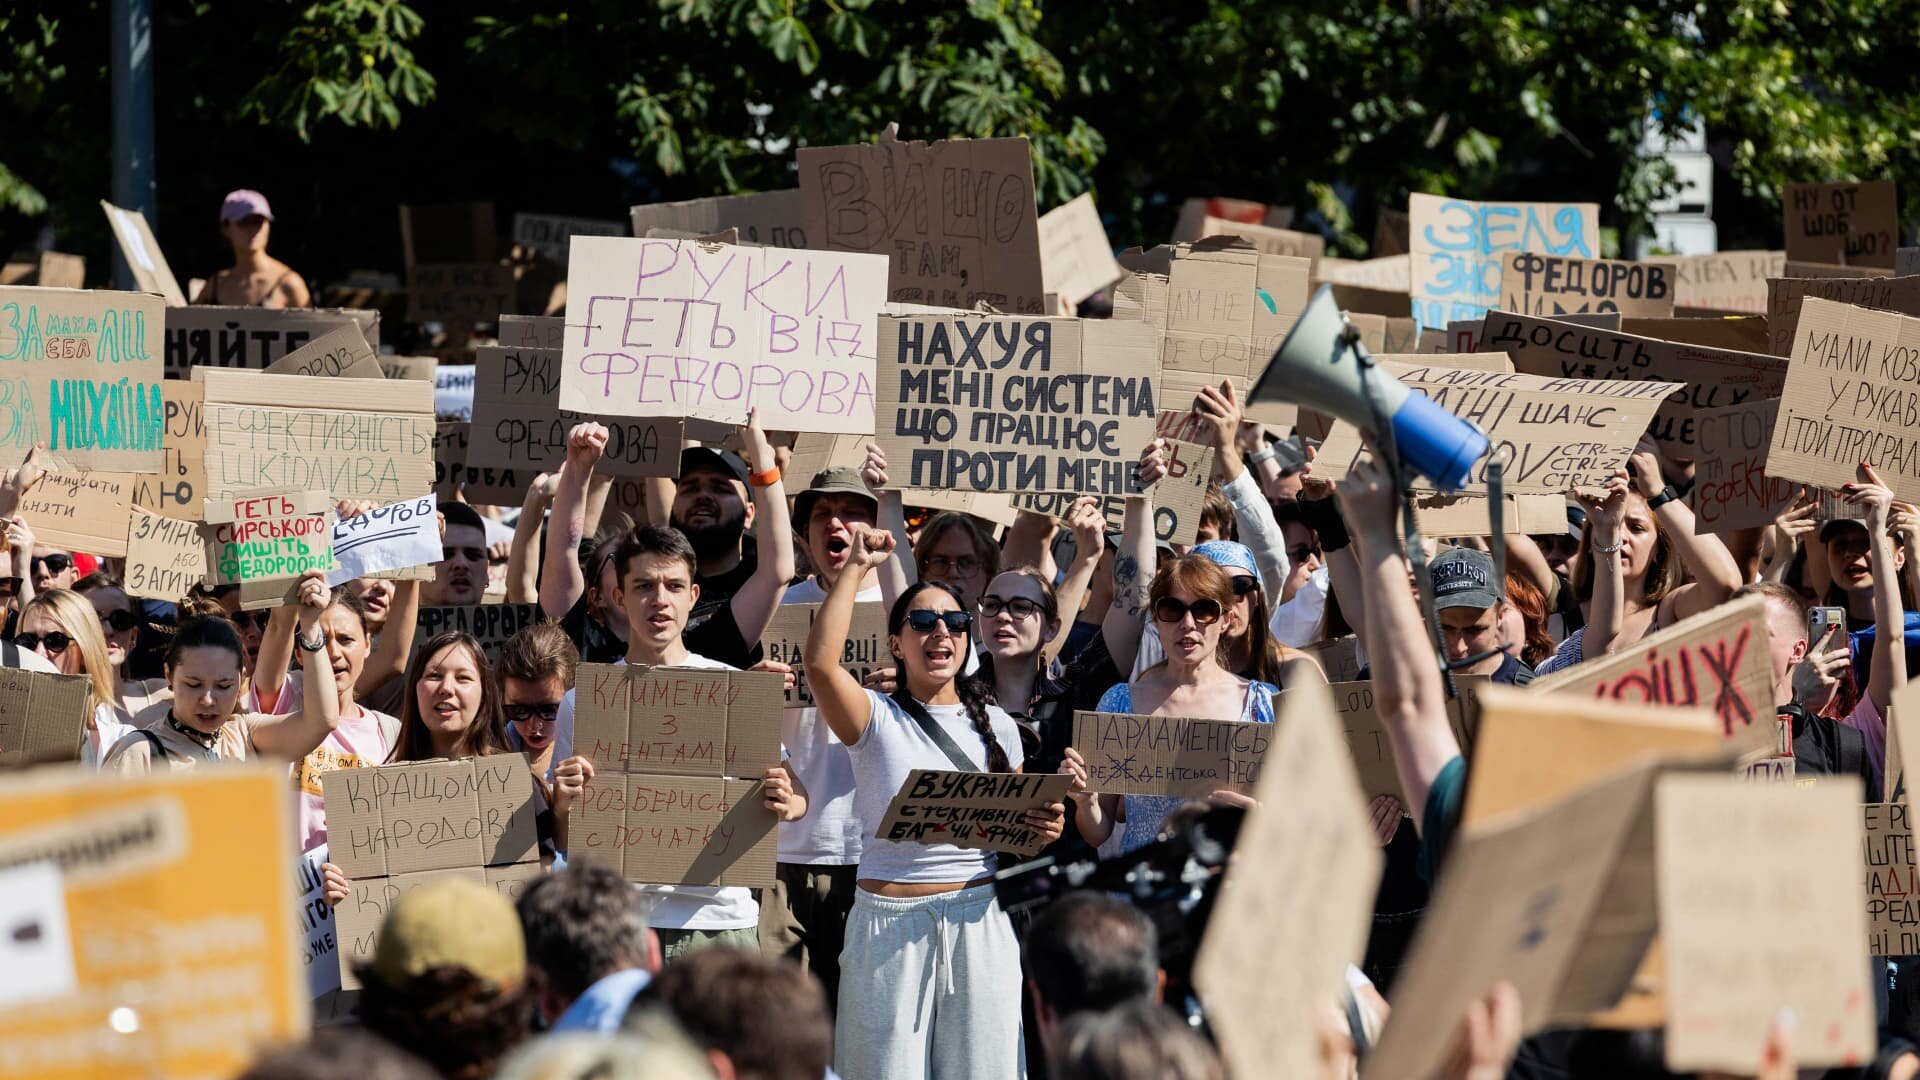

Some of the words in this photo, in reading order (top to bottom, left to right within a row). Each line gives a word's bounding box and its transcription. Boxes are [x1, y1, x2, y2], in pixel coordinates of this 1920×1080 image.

[1424, 202, 1592, 258] ЗЕЛЯ
[636, 242, 849, 320] РУКИ
[1512, 252, 1668, 299] ФЕДОРОВ
[584, 295, 736, 348] ГЕТЬ
[1491, 321, 1652, 369] ДОСИТЬ
[897, 321, 1051, 371] НАХУЯ
[1804, 330, 1872, 376] МАЛИ
[579, 352, 876, 417] ФЕДОРОВА
[899, 369, 993, 409] МЕНІ
[1002, 374, 1155, 418] СИСТЕМА
[1826, 376, 1851, 412] У
[1852, 381, 1920, 427] РУКАВ
[218, 407, 427, 456] ЕФЕКТИВНІСТЬ
[895, 408, 958, 444] ЩО
[969, 411, 1120, 457] ПРАЦЮЄ
[1518, 401, 1617, 428] ШАНС
[495, 417, 660, 464] ФЕДОВА
[1833, 425, 1920, 478] ПРОСРАЛ
[910, 448, 1046, 492] ПРОТИ
[1056, 456, 1143, 495] МЕНЕ
[17, 501, 76, 519] ьняти
[216, 517, 325, 544] СИРСЬКОГО
[234, 495, 296, 519] ГЕТЬ
[592, 671, 741, 713] КЛИМЕНКО
[657, 714, 679, 736] З
[592, 738, 737, 765] МЕНТАМИ
[346, 765, 513, 814] КРАЩОМУ
[1866, 899, 1920, 929] ФЕД
